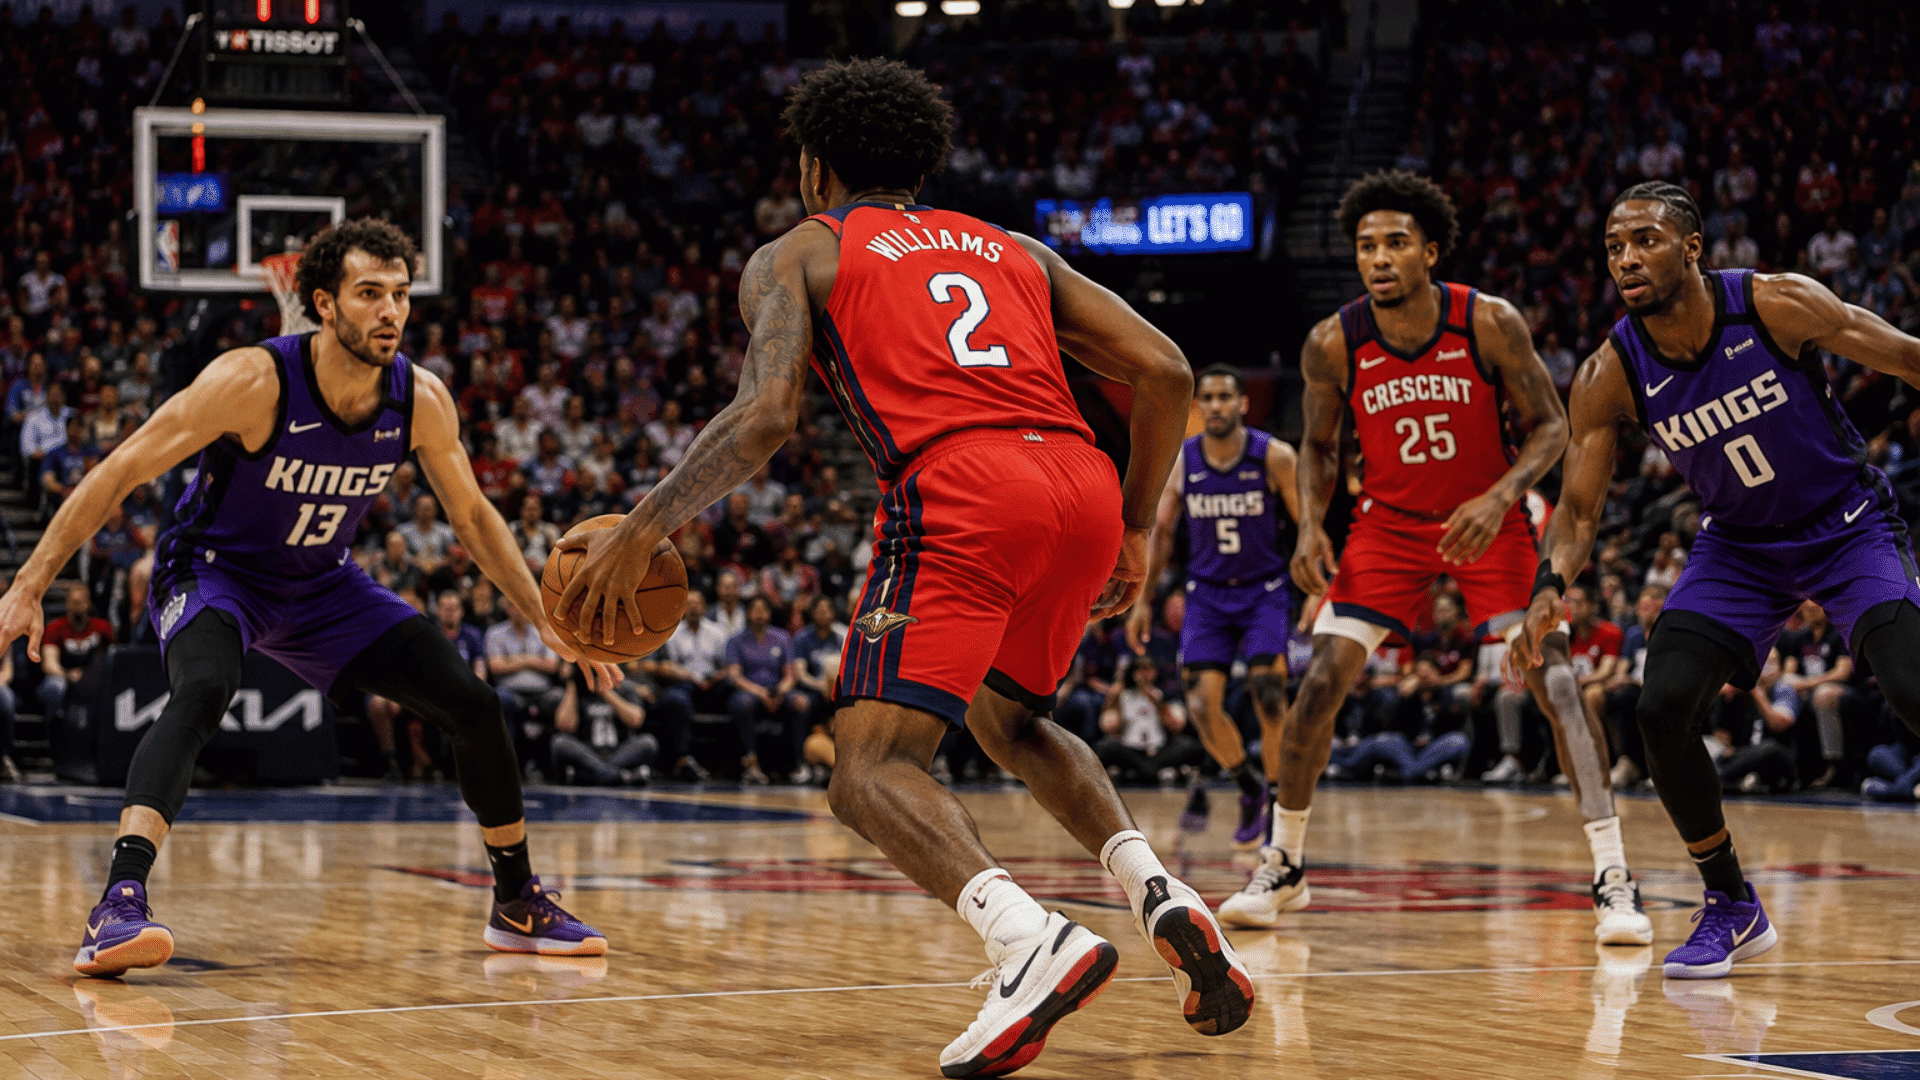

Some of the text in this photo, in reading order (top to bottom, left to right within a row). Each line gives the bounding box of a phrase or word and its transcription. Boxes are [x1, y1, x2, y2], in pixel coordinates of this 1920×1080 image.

[249, 29, 339, 54] TISSOT
[866, 228, 1003, 262] WILLIAMS
[927, 271, 1012, 368] 2
[1362, 374, 1473, 415] CRESCENT
[1653, 369, 1789, 452] KINGS
[1395, 413, 1457, 464] 25
[265, 455, 396, 496] KINGS
[1723, 434, 1776, 488] 0
[1186, 490, 1264, 518] KINGS
[285, 503, 348, 547] 13
[1215, 518, 1241, 554] 5
